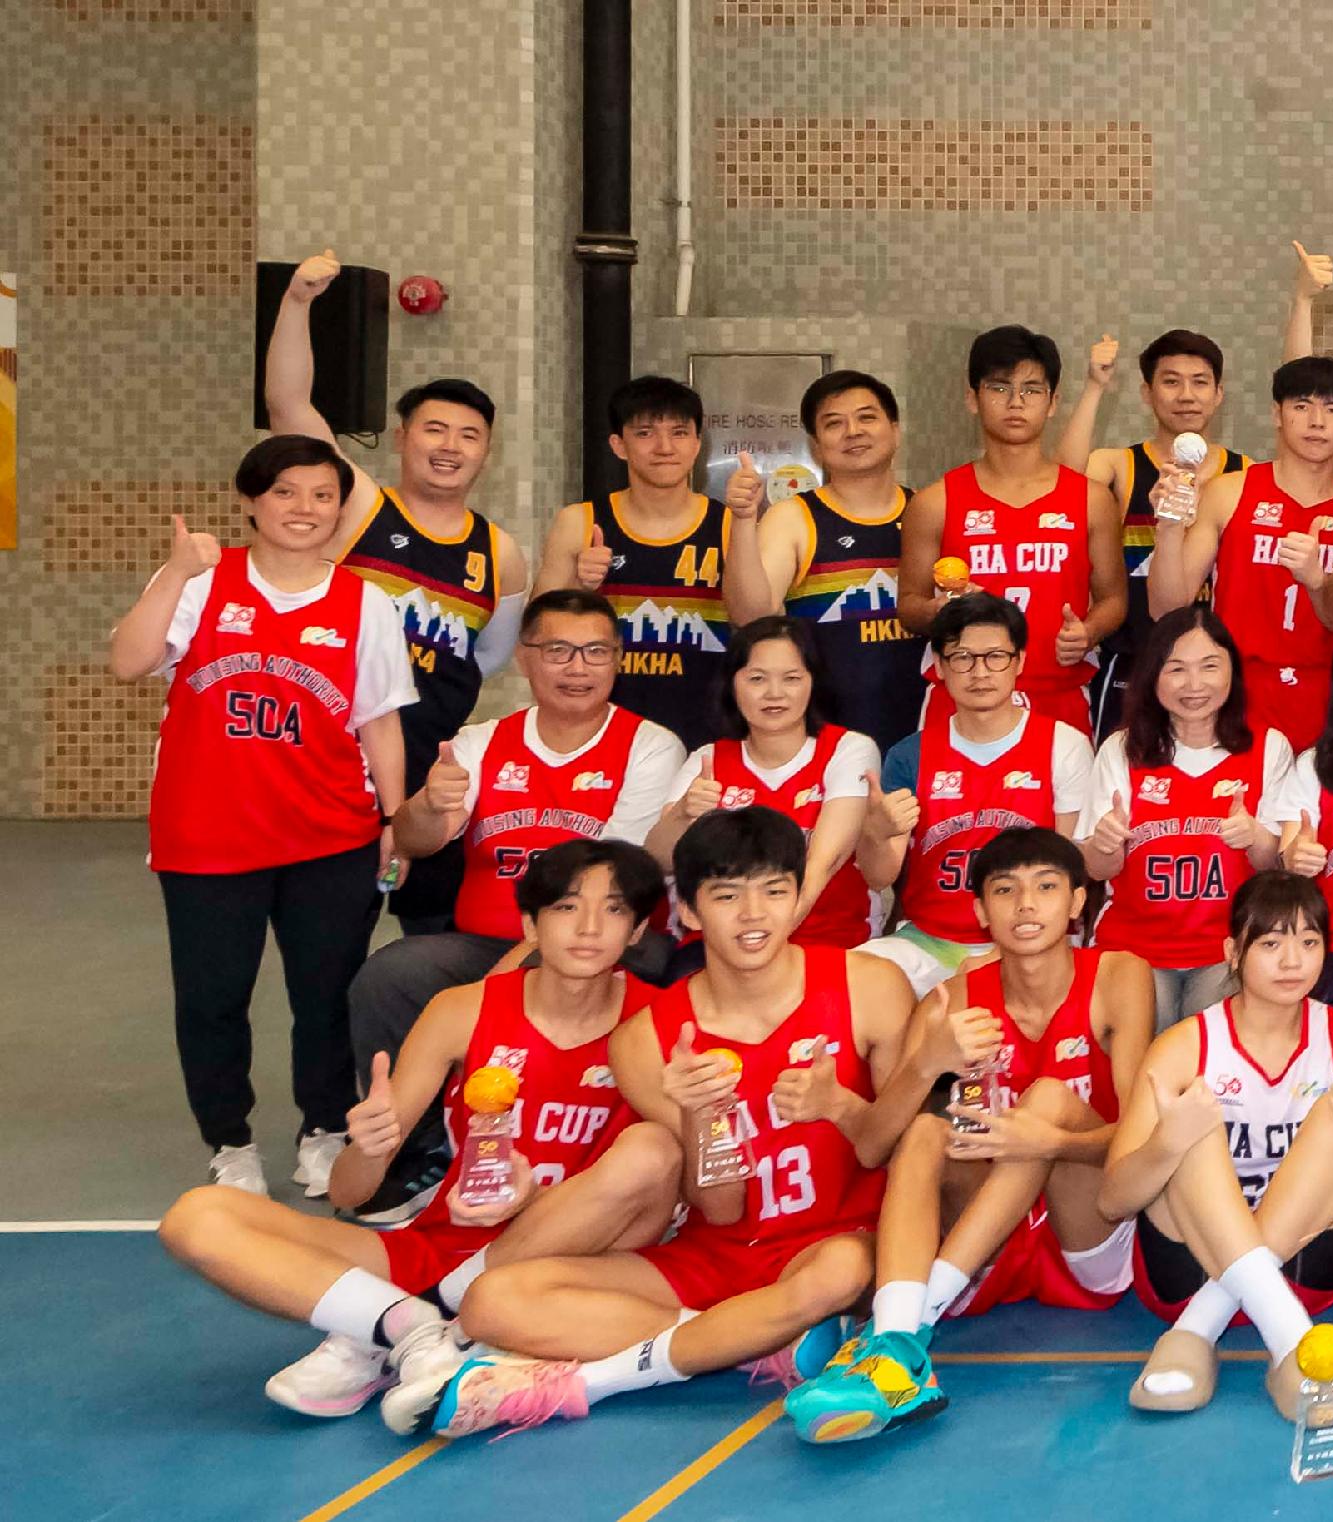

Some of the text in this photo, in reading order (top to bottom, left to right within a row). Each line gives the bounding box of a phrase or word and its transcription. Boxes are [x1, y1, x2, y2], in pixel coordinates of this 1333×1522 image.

[463, 550, 486, 592] 9
[674, 544, 719, 587] 44
[969, 542, 1068, 574] HA CUP
[1282, 584, 1298, 631] 1
[266, 655, 349, 716] AUTHORITY
[964, 1086, 982, 1100] 50
[534, 1102, 610, 1144] CUP
[757, 1144, 816, 1221] 13
